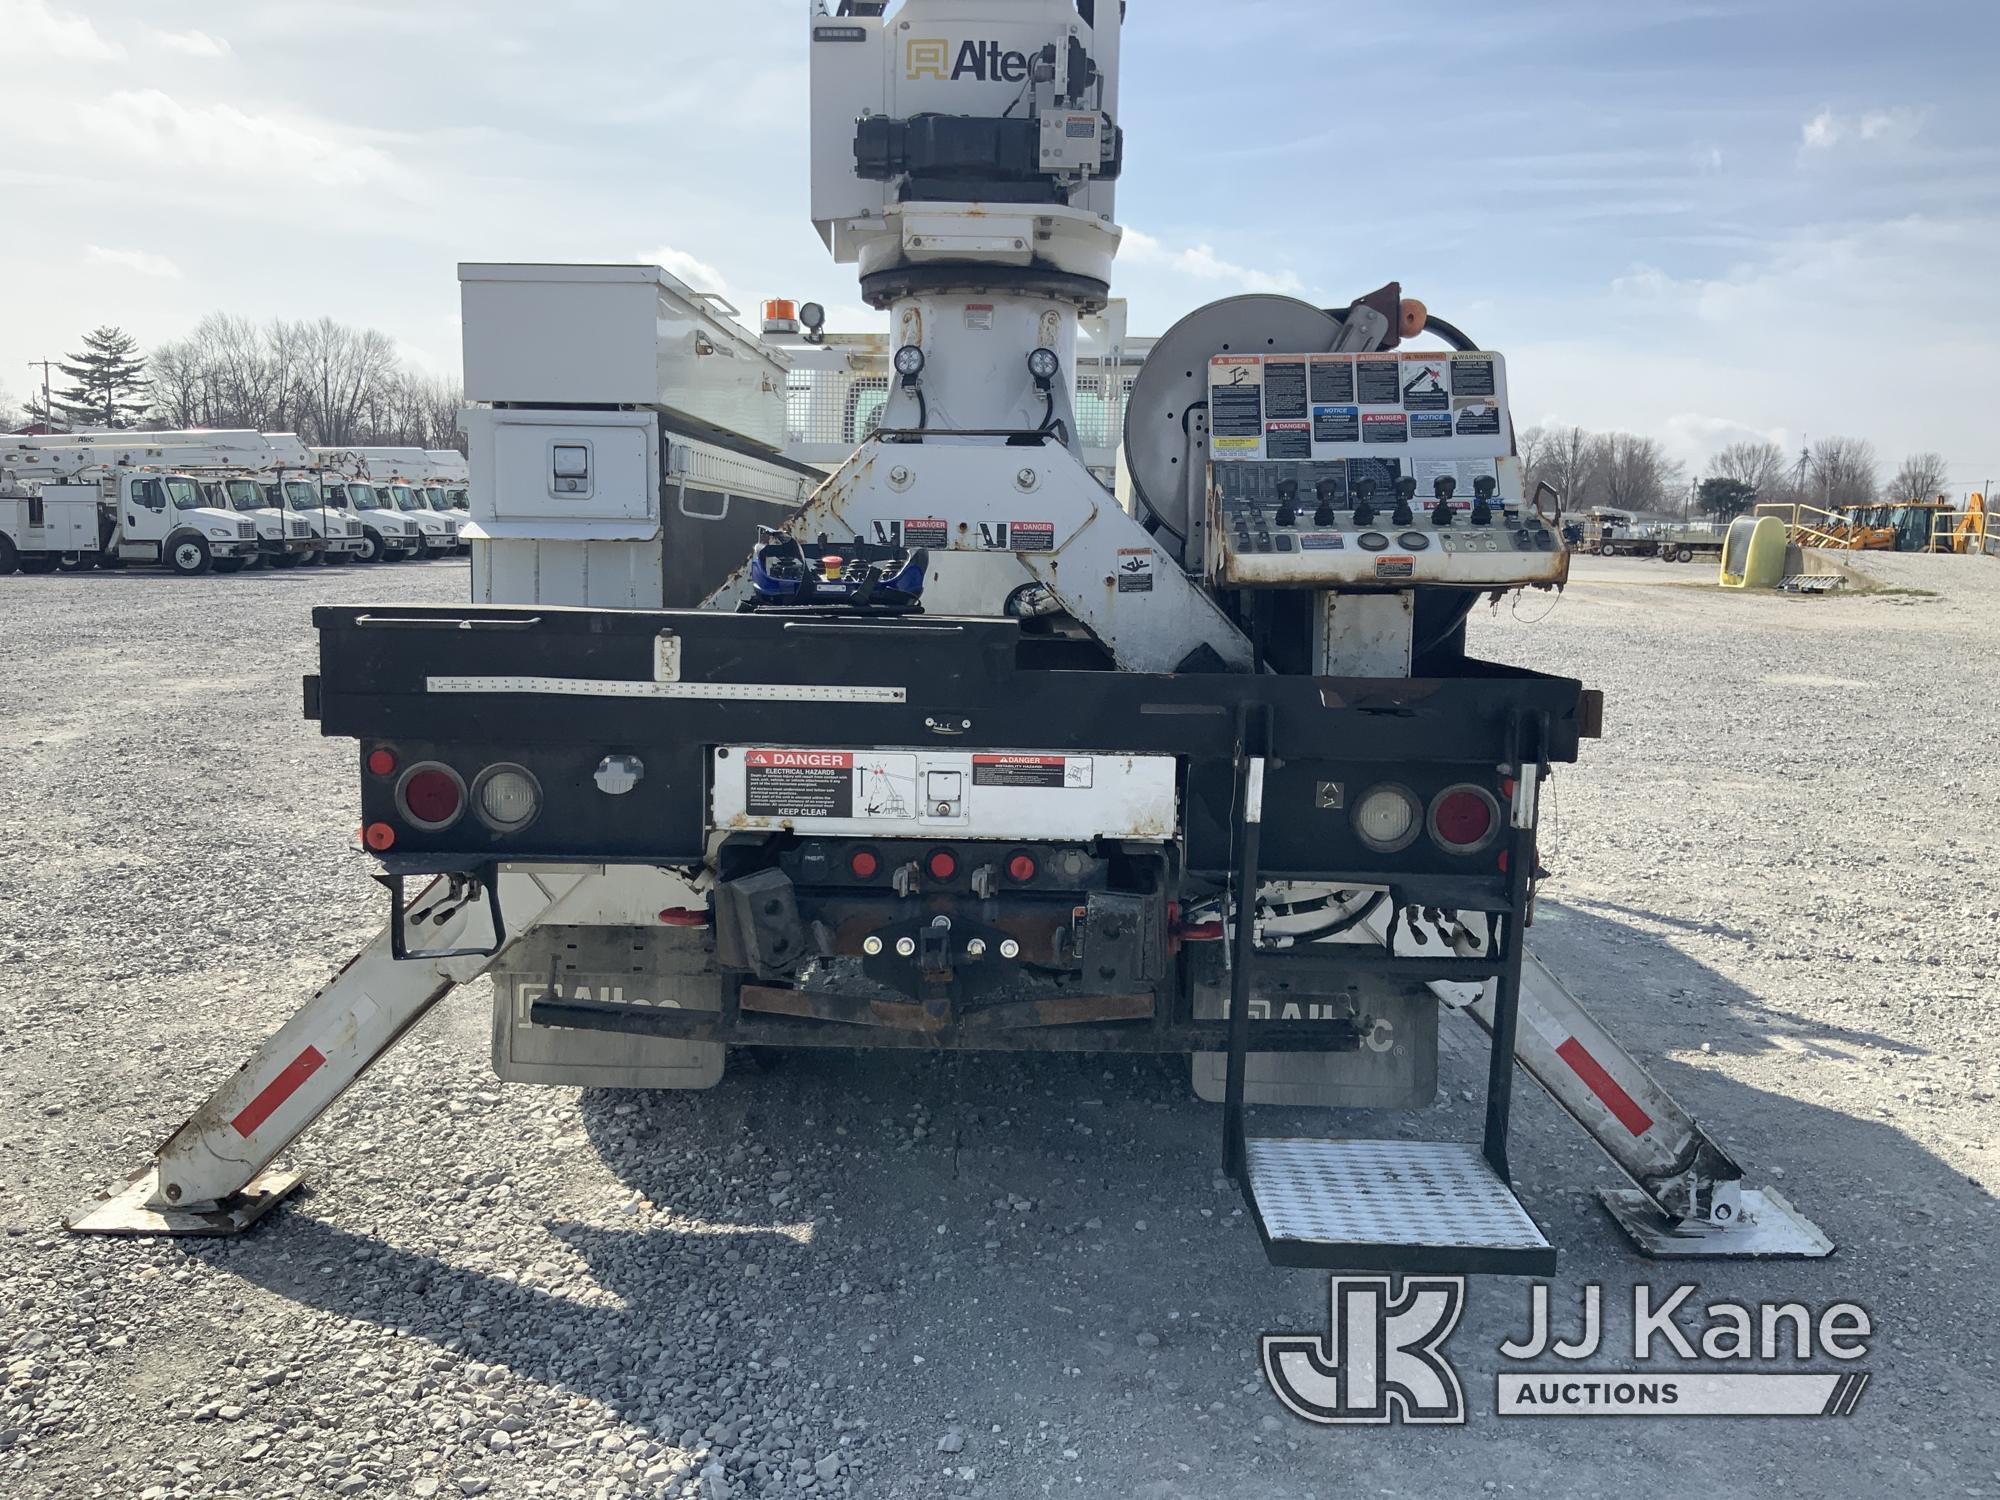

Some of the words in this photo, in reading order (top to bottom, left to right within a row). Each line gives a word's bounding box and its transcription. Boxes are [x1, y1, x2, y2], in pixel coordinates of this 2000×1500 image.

[916, 521, 946, 529] DANGER
[1023, 523, 1052, 531] DANGER
[773, 753, 843, 766] DANGER
[1008, 756, 1041, 764] DANGER
[801, 808, 827, 816] CLEAR
